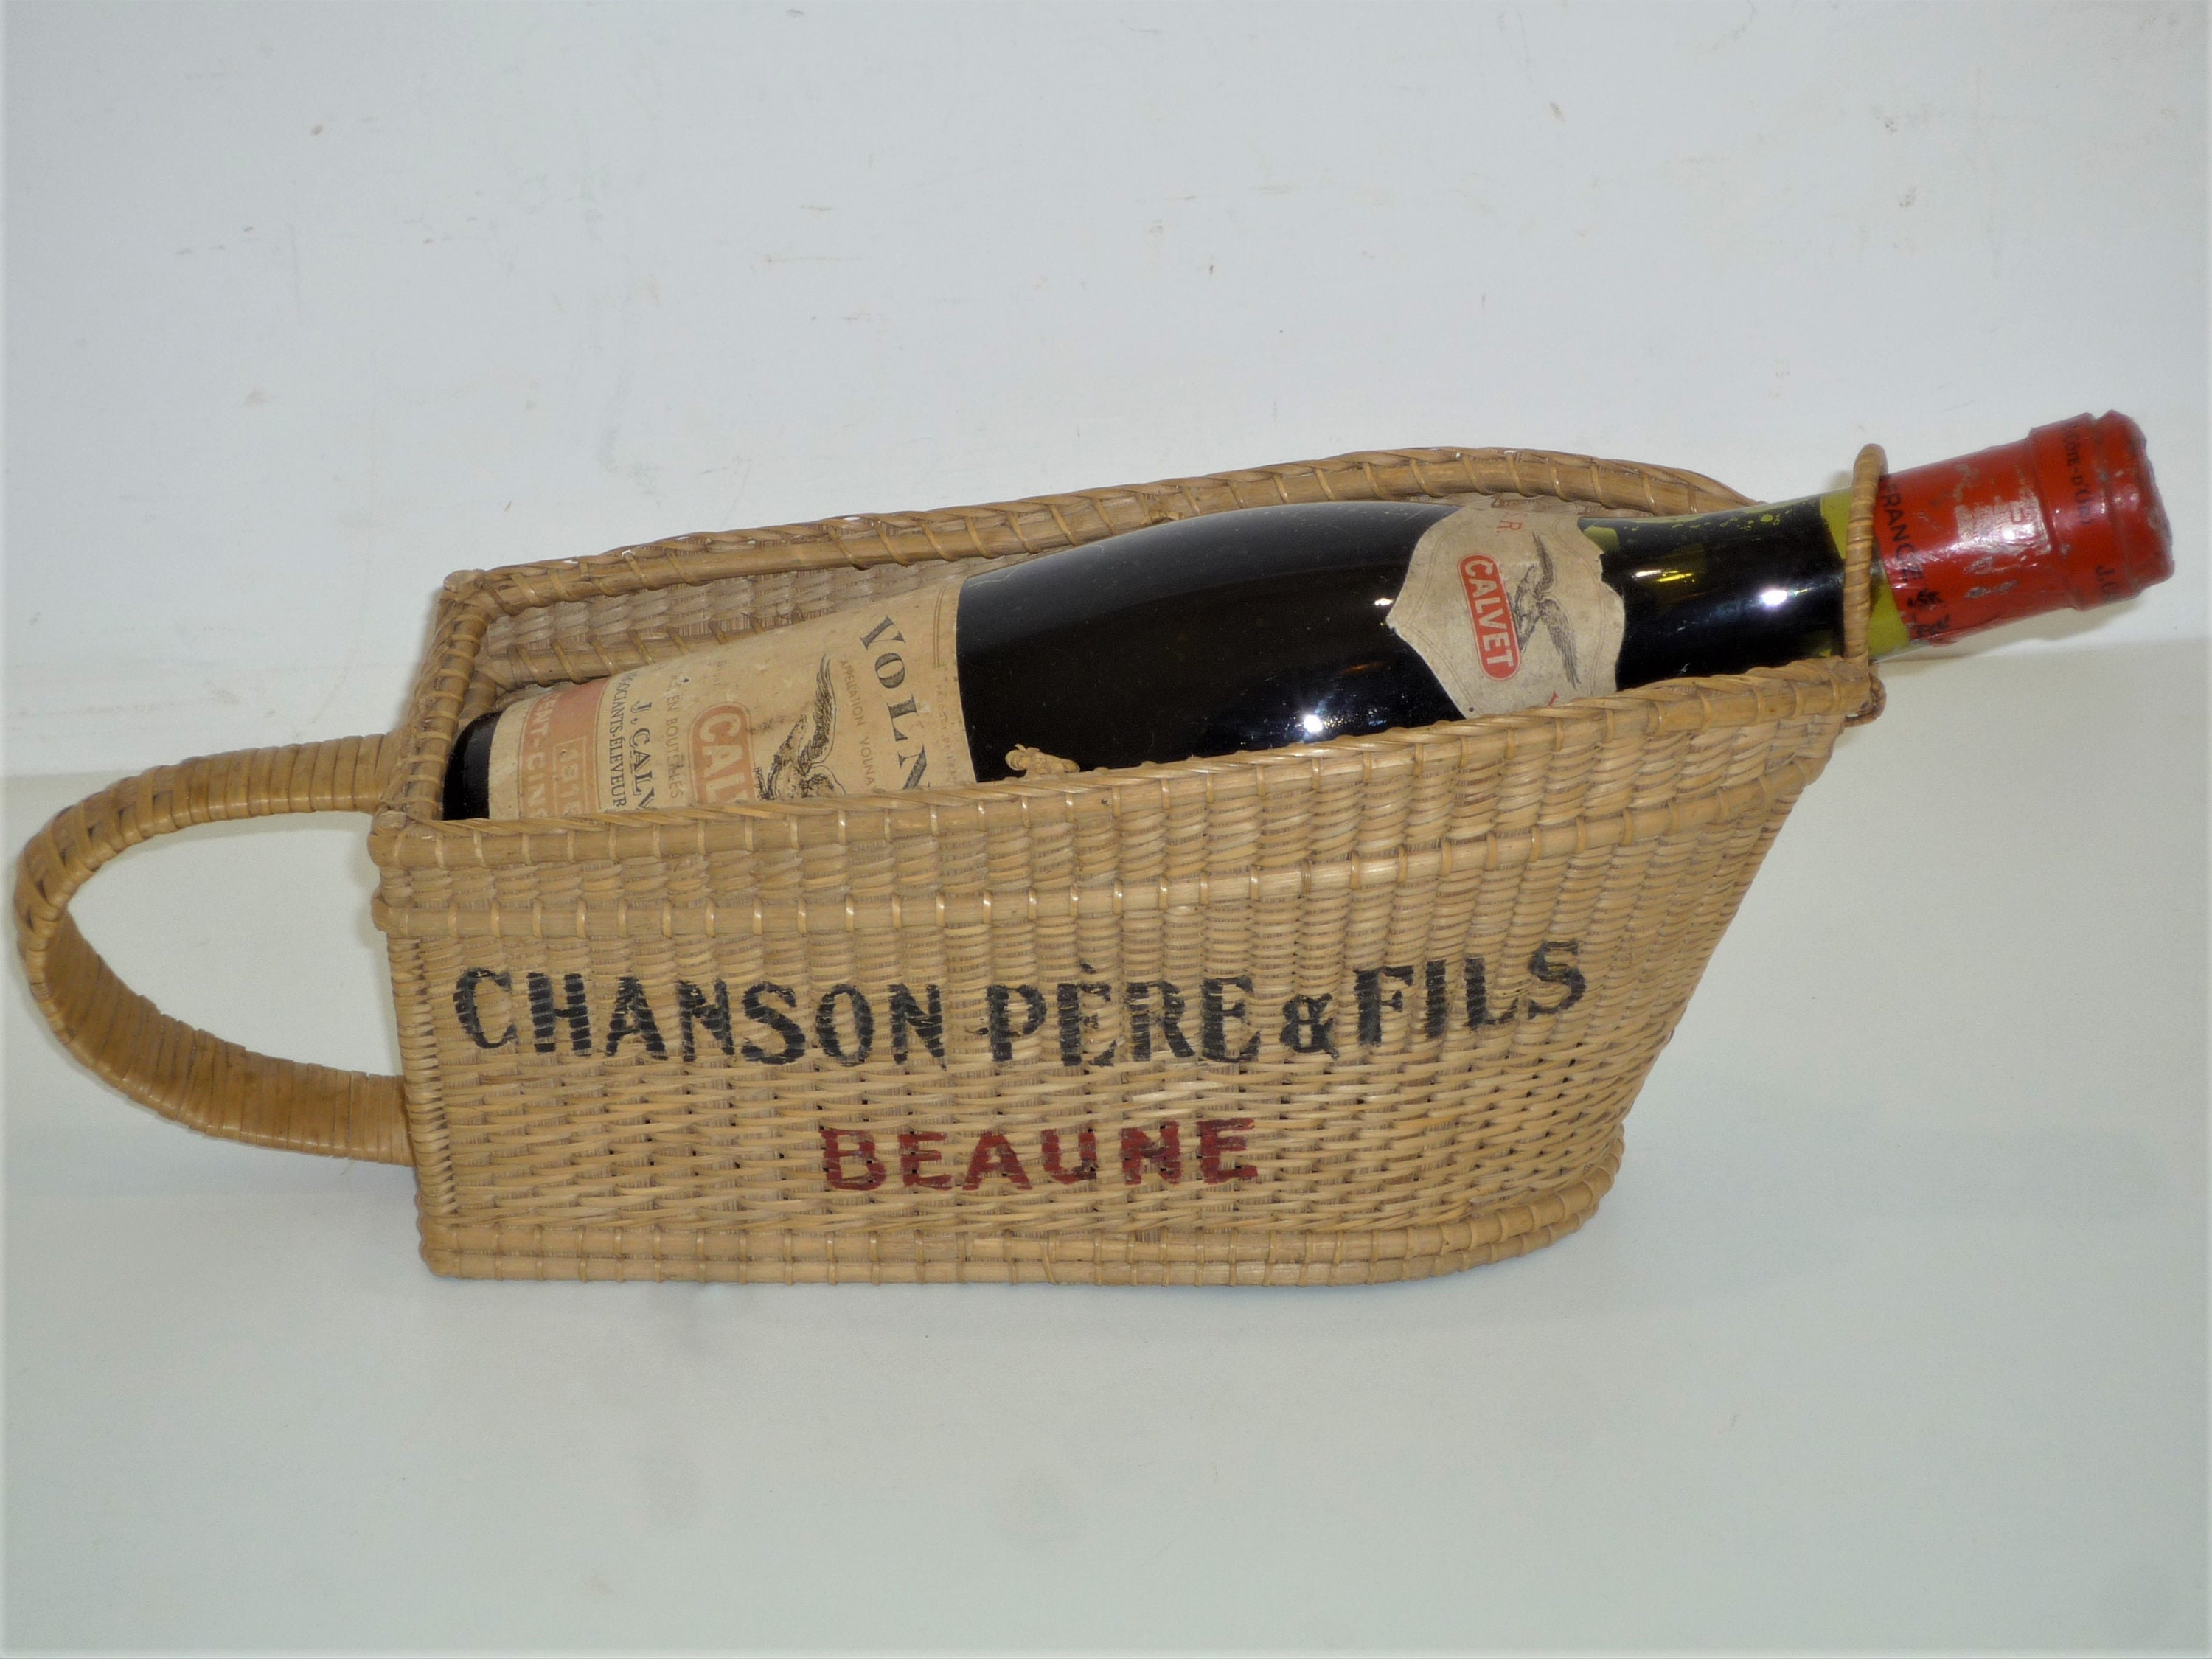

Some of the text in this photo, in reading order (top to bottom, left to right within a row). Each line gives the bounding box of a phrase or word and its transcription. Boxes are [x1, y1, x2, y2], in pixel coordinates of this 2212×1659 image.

[1465, 559, 1515, 667] CALVET
[841, 655, 866, 726] APPELLATION
[453, 967, 947, 1069] CHANSON
[1280, 994, 1340, 1059] &
[1355, 940, 1587, 1045] FILS
[820, 1117, 1258, 1190] BEAUNE
